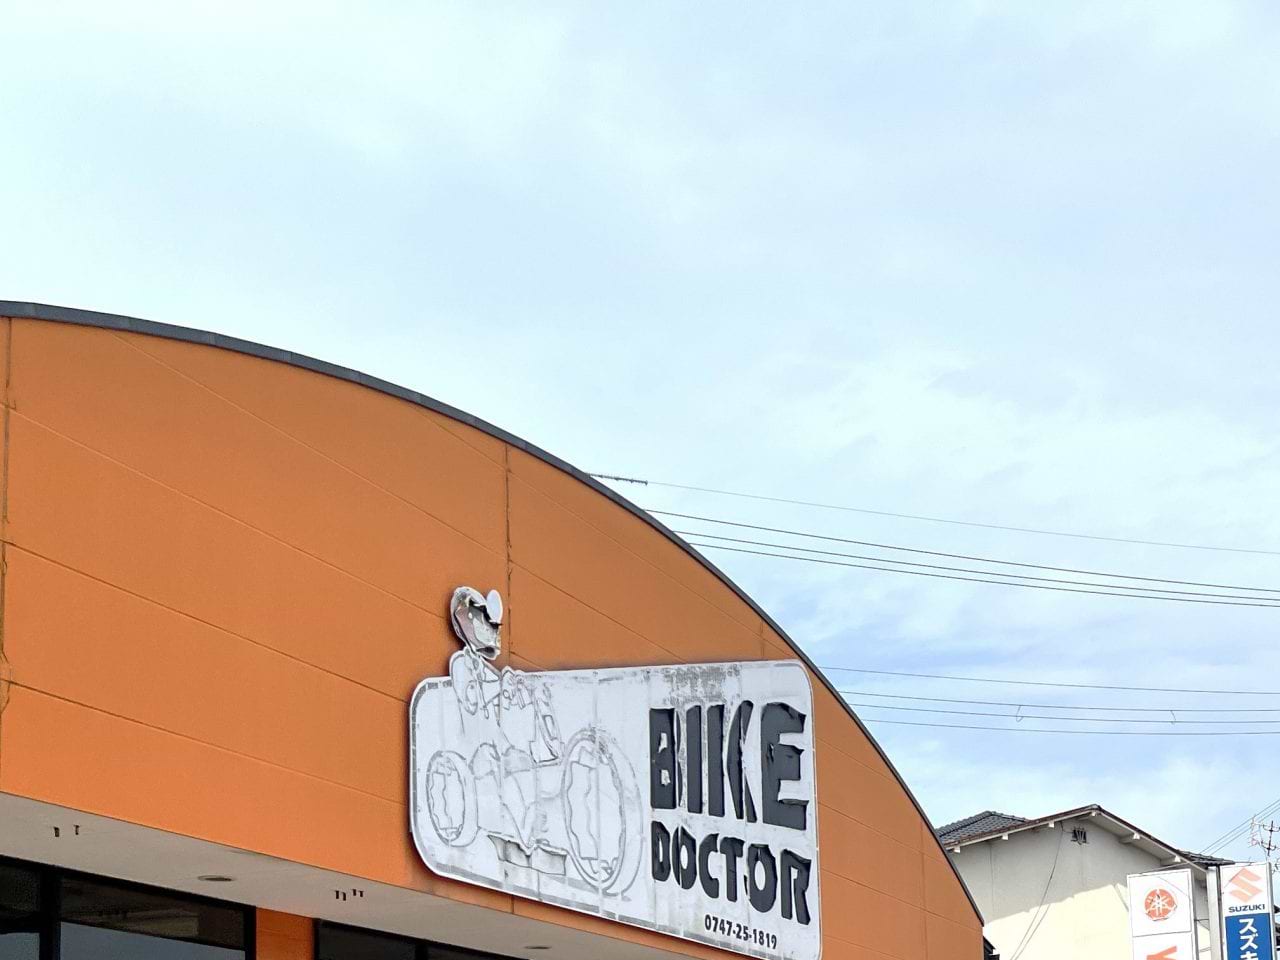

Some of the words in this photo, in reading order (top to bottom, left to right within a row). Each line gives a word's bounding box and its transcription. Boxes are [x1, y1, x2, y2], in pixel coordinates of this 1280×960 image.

[649, 699, 811, 831] BIKE
[650, 820, 812, 925] DOCTOR
[704, 914, 777, 950] 0747-25-1819
[1228, 903, 1266, 913] SUZUKI
